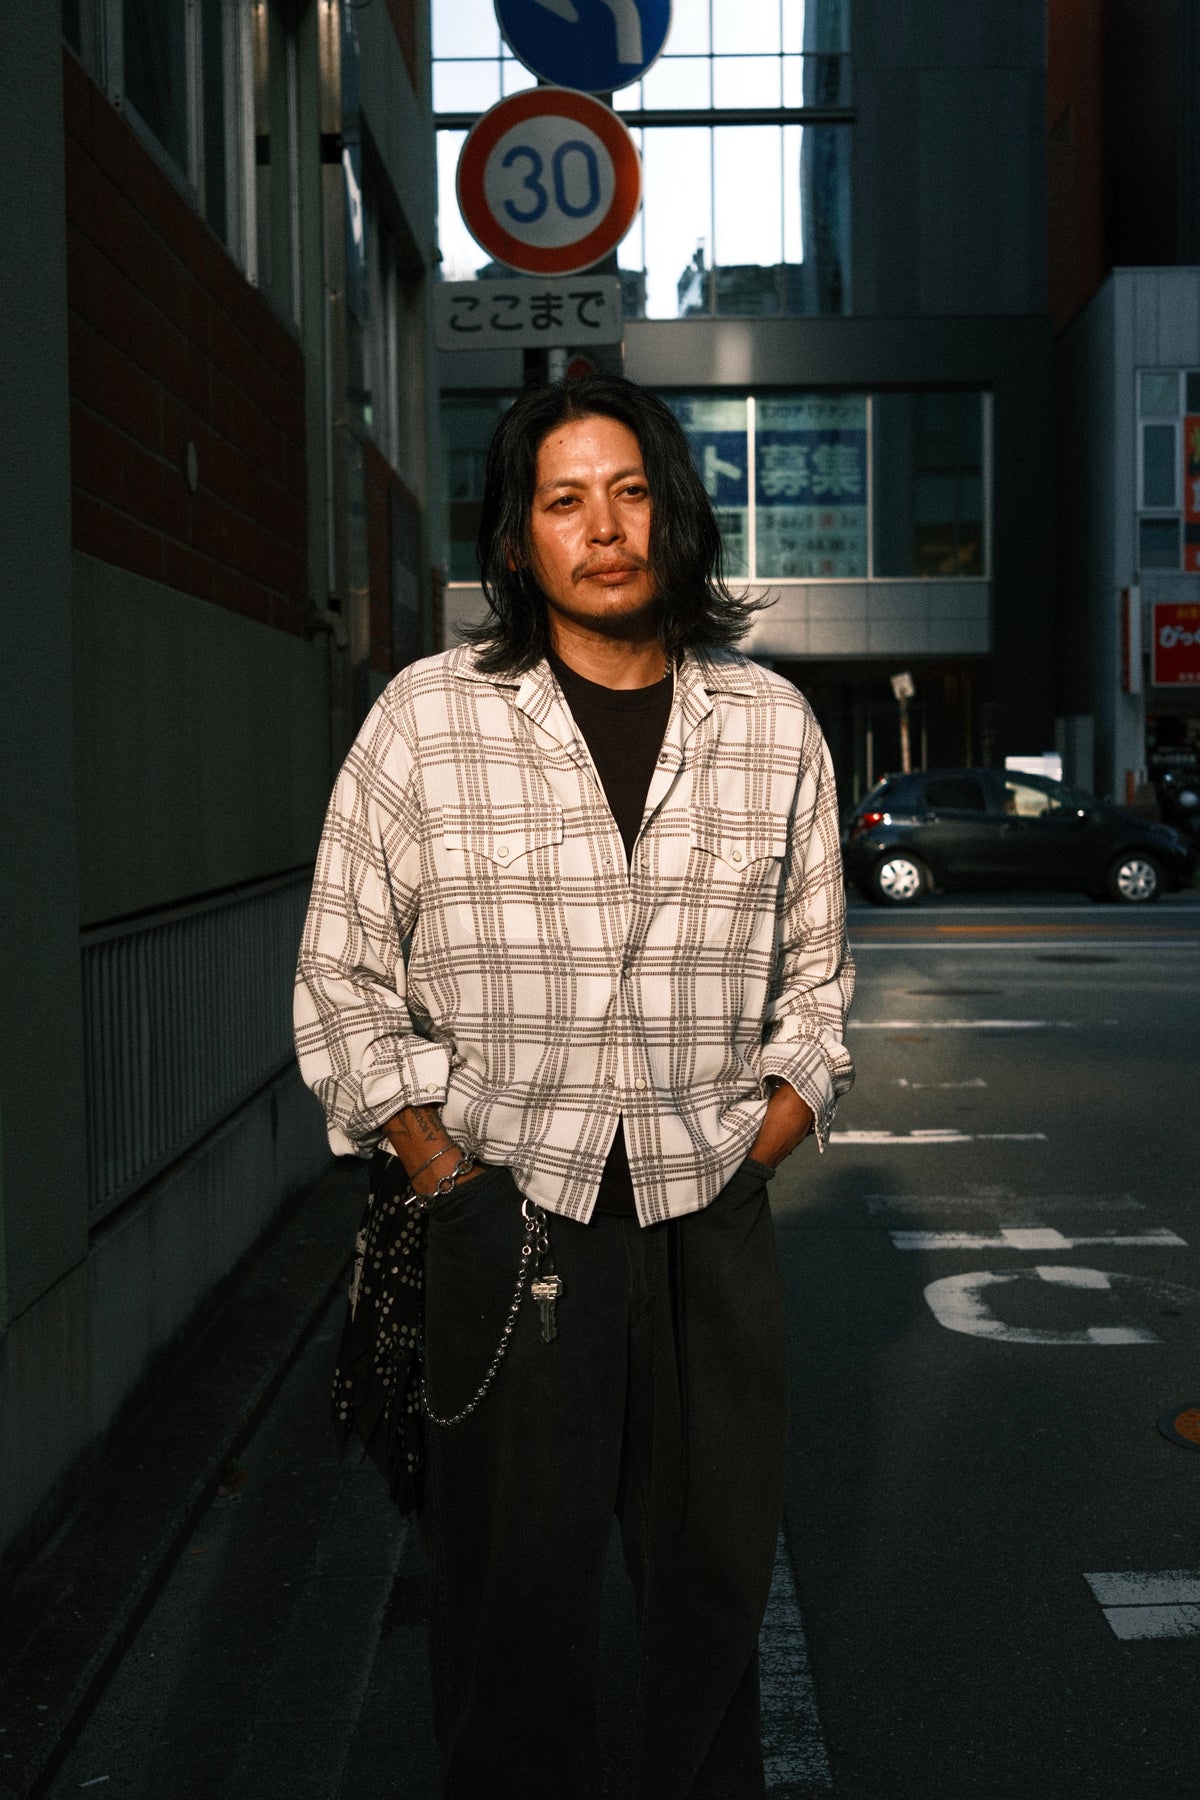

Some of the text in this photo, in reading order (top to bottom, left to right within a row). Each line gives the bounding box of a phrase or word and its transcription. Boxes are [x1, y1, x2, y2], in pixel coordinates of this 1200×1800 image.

[501, 140, 601, 224] 30
[450, 291, 606, 333] ここまで
